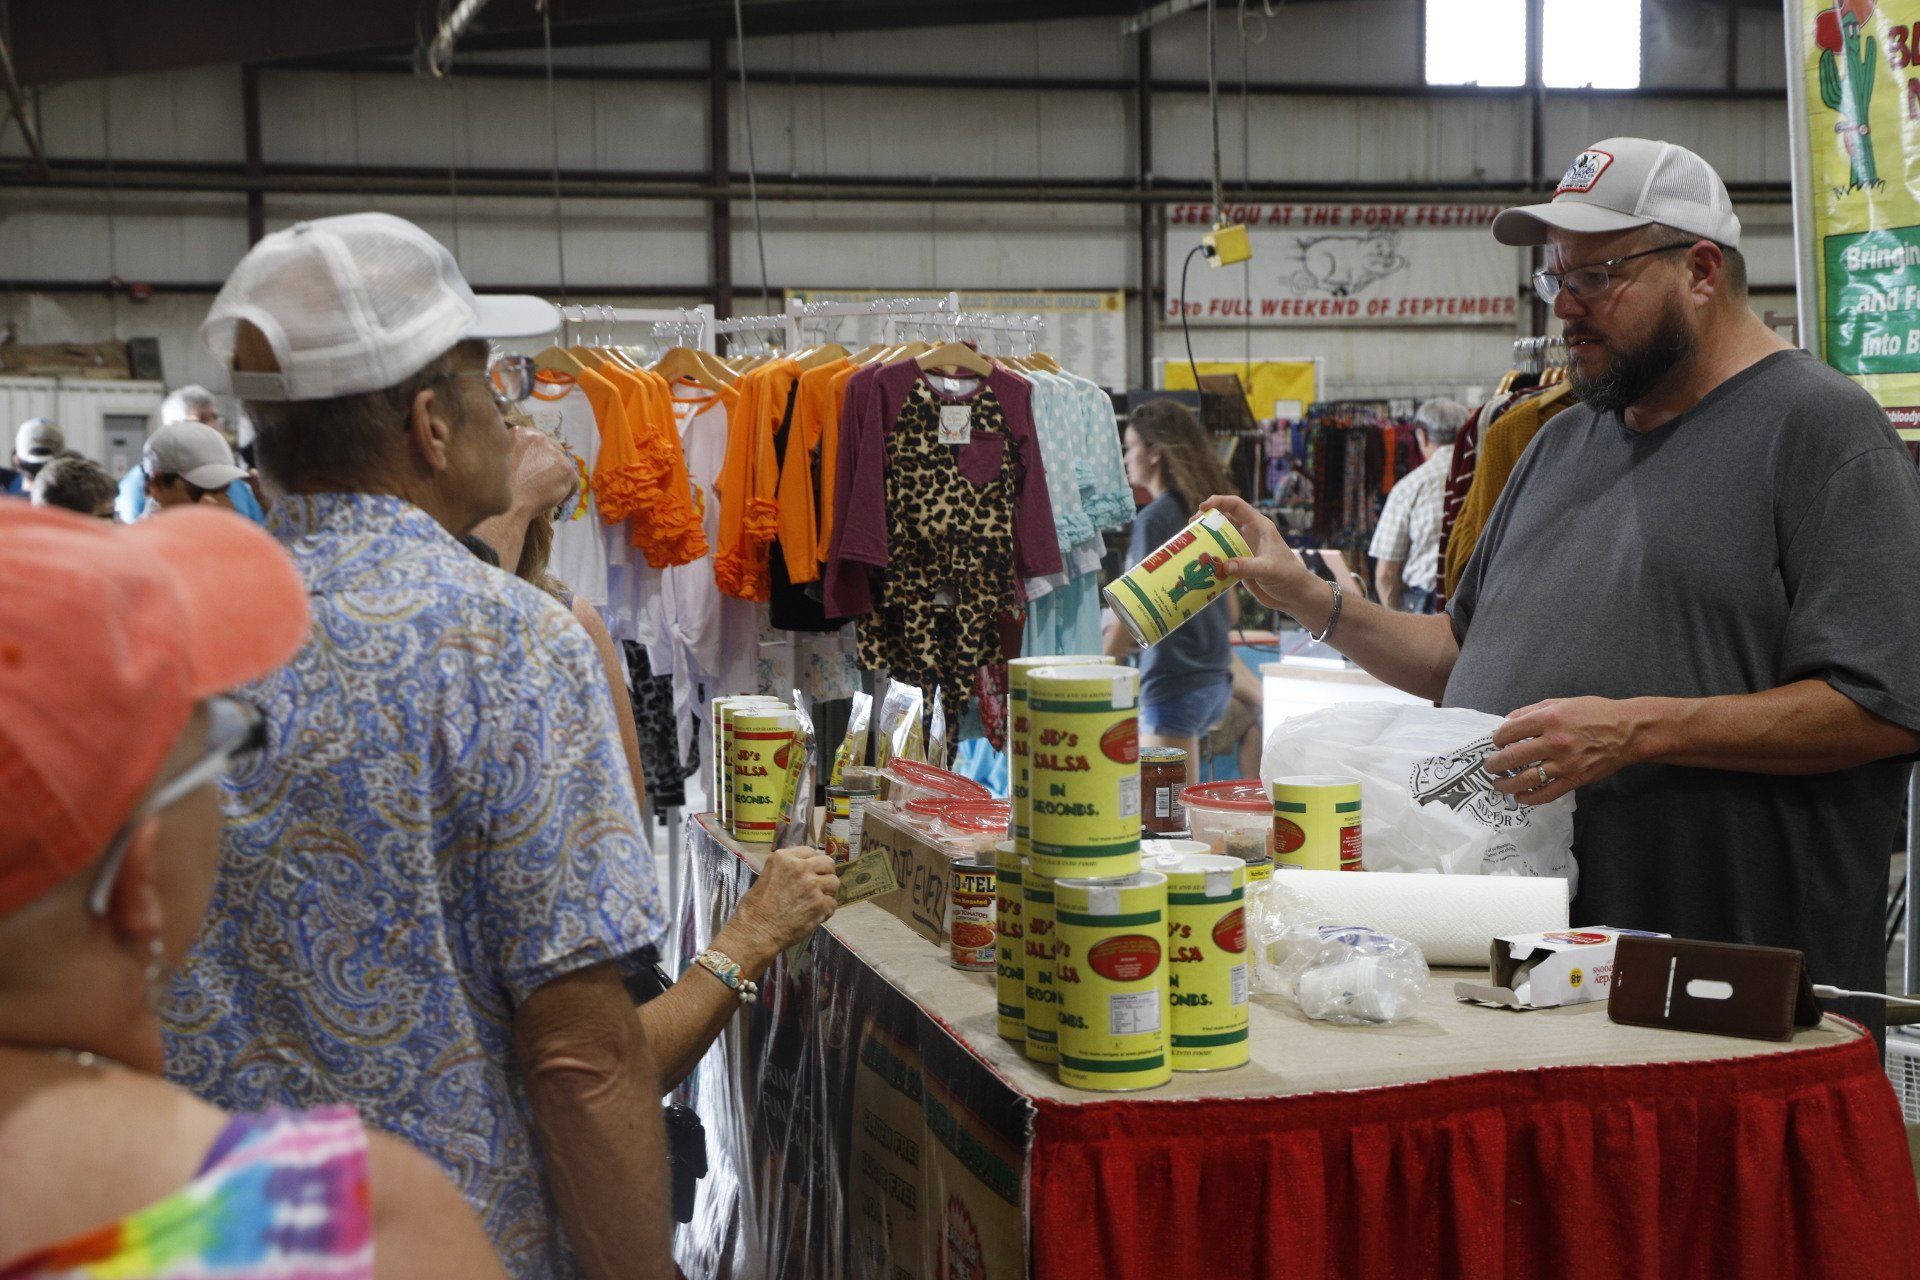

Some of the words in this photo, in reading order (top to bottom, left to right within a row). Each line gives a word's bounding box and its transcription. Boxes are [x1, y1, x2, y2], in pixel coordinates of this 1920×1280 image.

[1172, 205, 1212, 225] SEE
[1268, 206, 1296, 225] AT
[1302, 205, 1344, 225] THE
[1350, 206, 1409, 226] PORK
[1415, 206, 1503, 225] FESTIVA
[1846, 242, 1920, 274] Bringin
[1209, 299, 1253, 316] FULL
[1261, 298, 1360, 316] WEEKEND
[1366, 298, 1390, 315] OF
[1398, 296, 1516, 316] SEPTEMBER
[1856, 286, 1900, 314] and
[1040, 728, 1079, 748] JD'S
[1033, 752, 1091, 772] SALSA
[743, 783, 753, 792] IN
[1050, 783, 1066, 798] IN
[826, 797, 838, 812] EL
[912, 864, 943, 922] EVER
[1001, 947, 1012, 961] IN
[1038, 971, 1053, 985] IN
[1570, 974, 1582, 984] 48
[1592, 973, 1613, 987] day
[1170, 993, 1213, 1007] ONDS.
